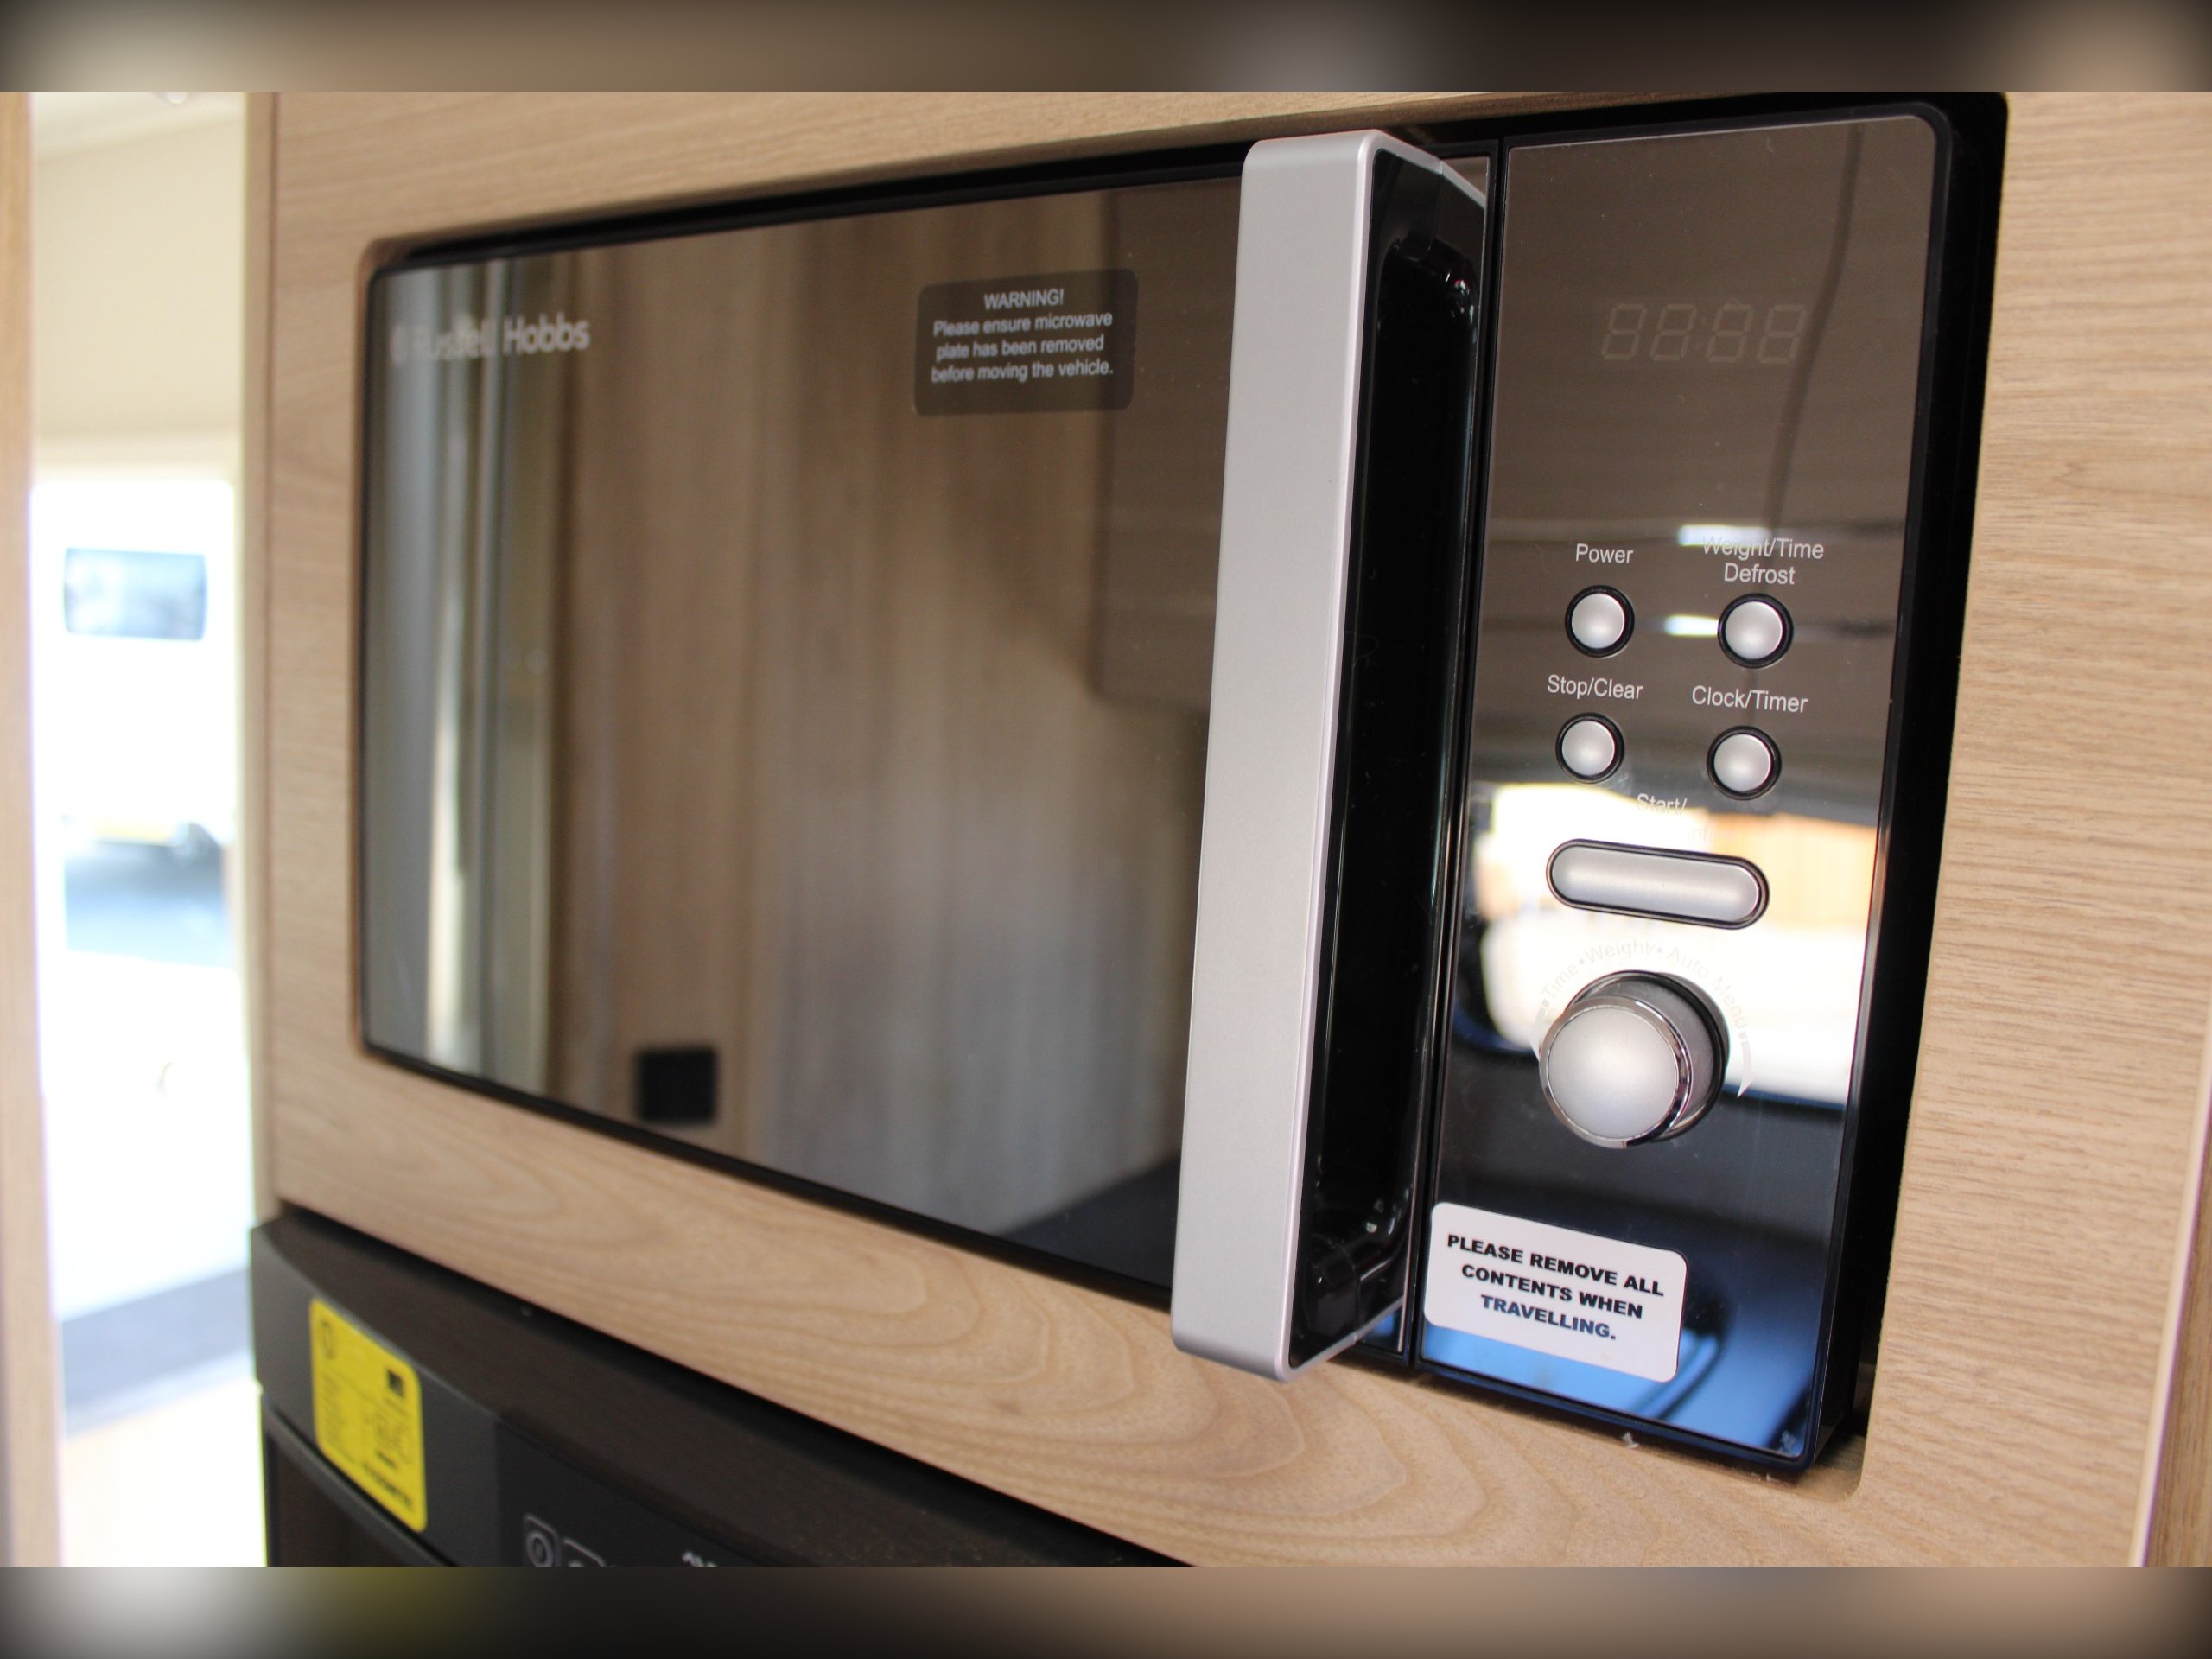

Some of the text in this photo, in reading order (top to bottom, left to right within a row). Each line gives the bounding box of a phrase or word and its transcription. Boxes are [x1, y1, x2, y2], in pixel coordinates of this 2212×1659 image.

[983, 289, 1065, 310] WARNING!
[503, 312, 591, 355] Hobbs
[933, 312, 1113, 337] Please ensure microwave
[936, 334, 1104, 363] plate has been removed
[931, 358, 1113, 383] before moving the vehicle.
[1575, 543, 1633, 563] Power
[1702, 536, 1825, 561] Weight/Time
[1724, 563, 1796, 585] Defrost
[1547, 674, 1643, 700] Stop/Clear
[1692, 685, 1808, 713] Clock/Timer
[1637, 793, 1688, 816] Start/
[1447, 1234, 1664, 1297] PLEASE REMOVE ALL
[1462, 1264, 1643, 1319] CONTENTS WHEN
[1480, 1294, 1617, 1340] TRAVELLING.
